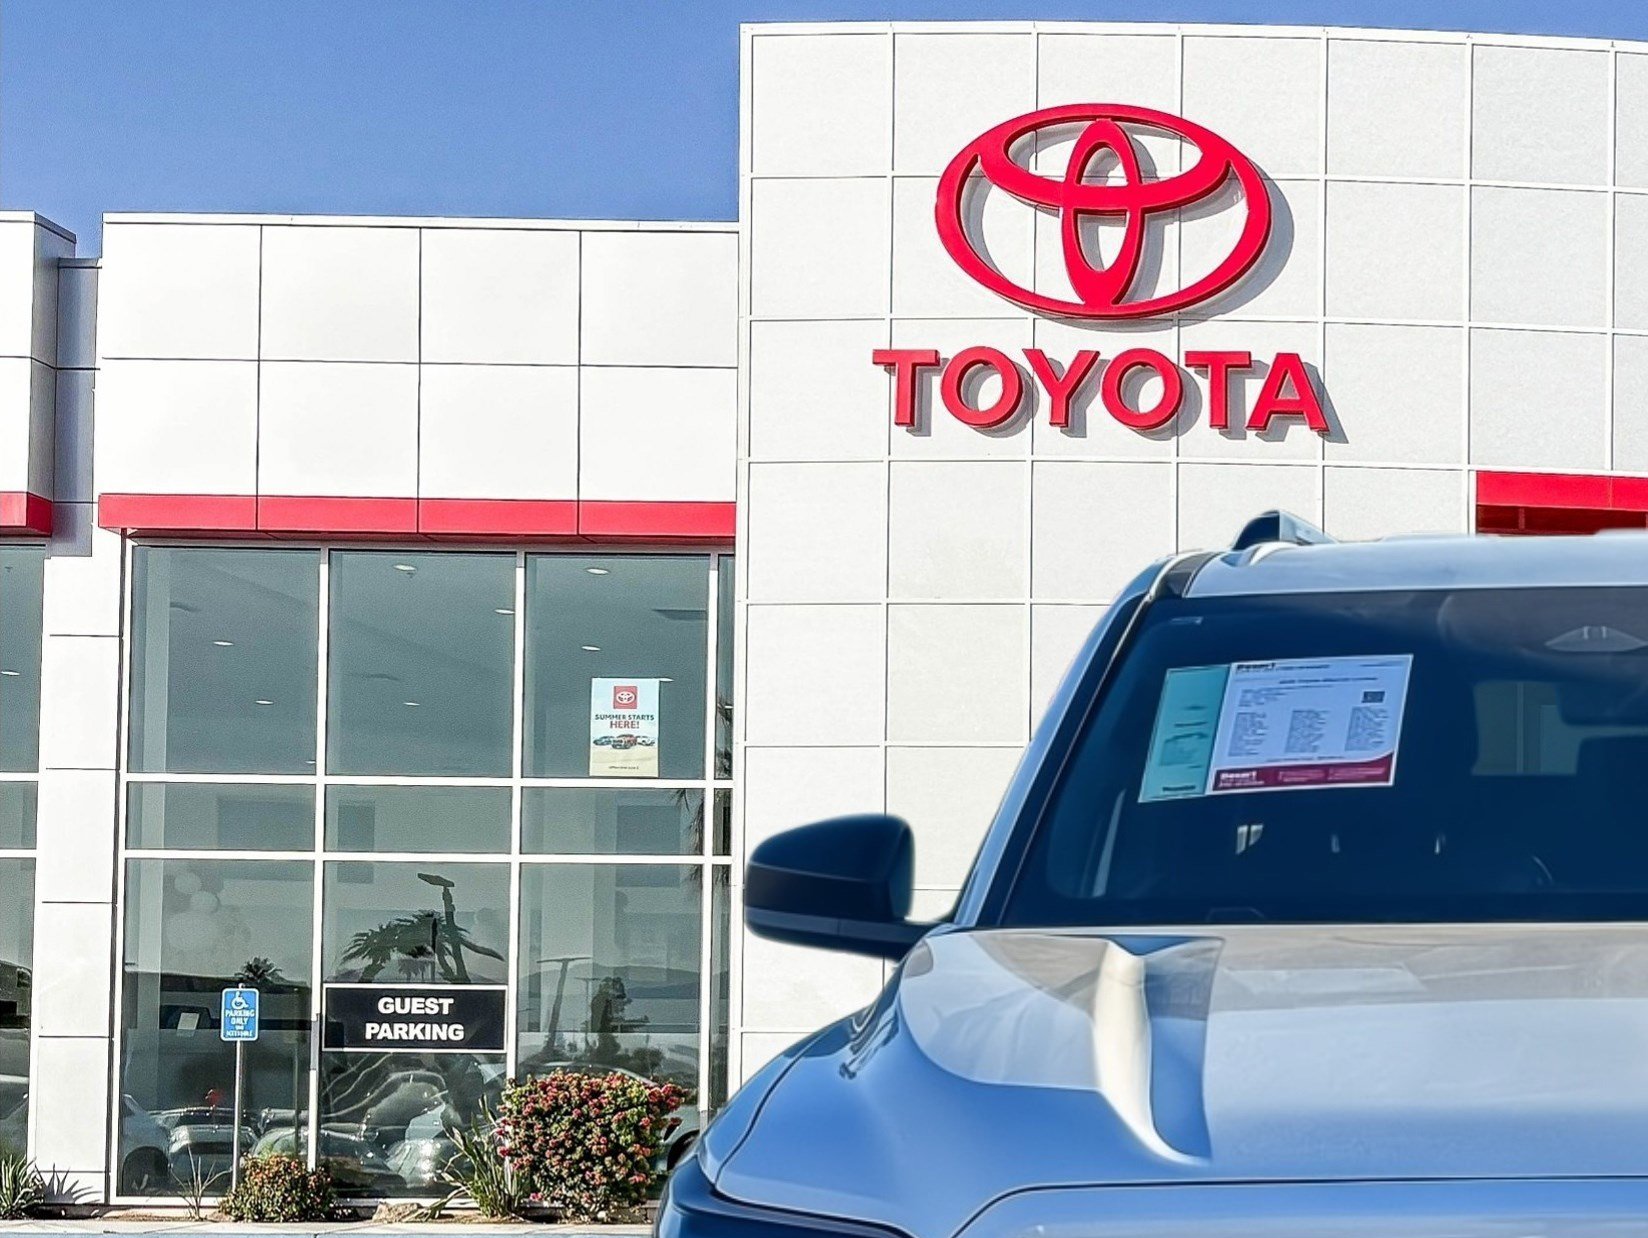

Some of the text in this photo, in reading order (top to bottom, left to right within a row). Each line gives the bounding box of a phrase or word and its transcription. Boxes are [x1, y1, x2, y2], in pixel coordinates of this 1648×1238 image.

[872, 346, 1331, 434] TOYOTA
[609, 721, 640, 729] HERE!
[377, 997, 454, 1015] GUEST
[225, 1009, 255, 1017] PARKING
[230, 1017, 249, 1025] ONLY
[365, 1023, 465, 1041] PARKING
